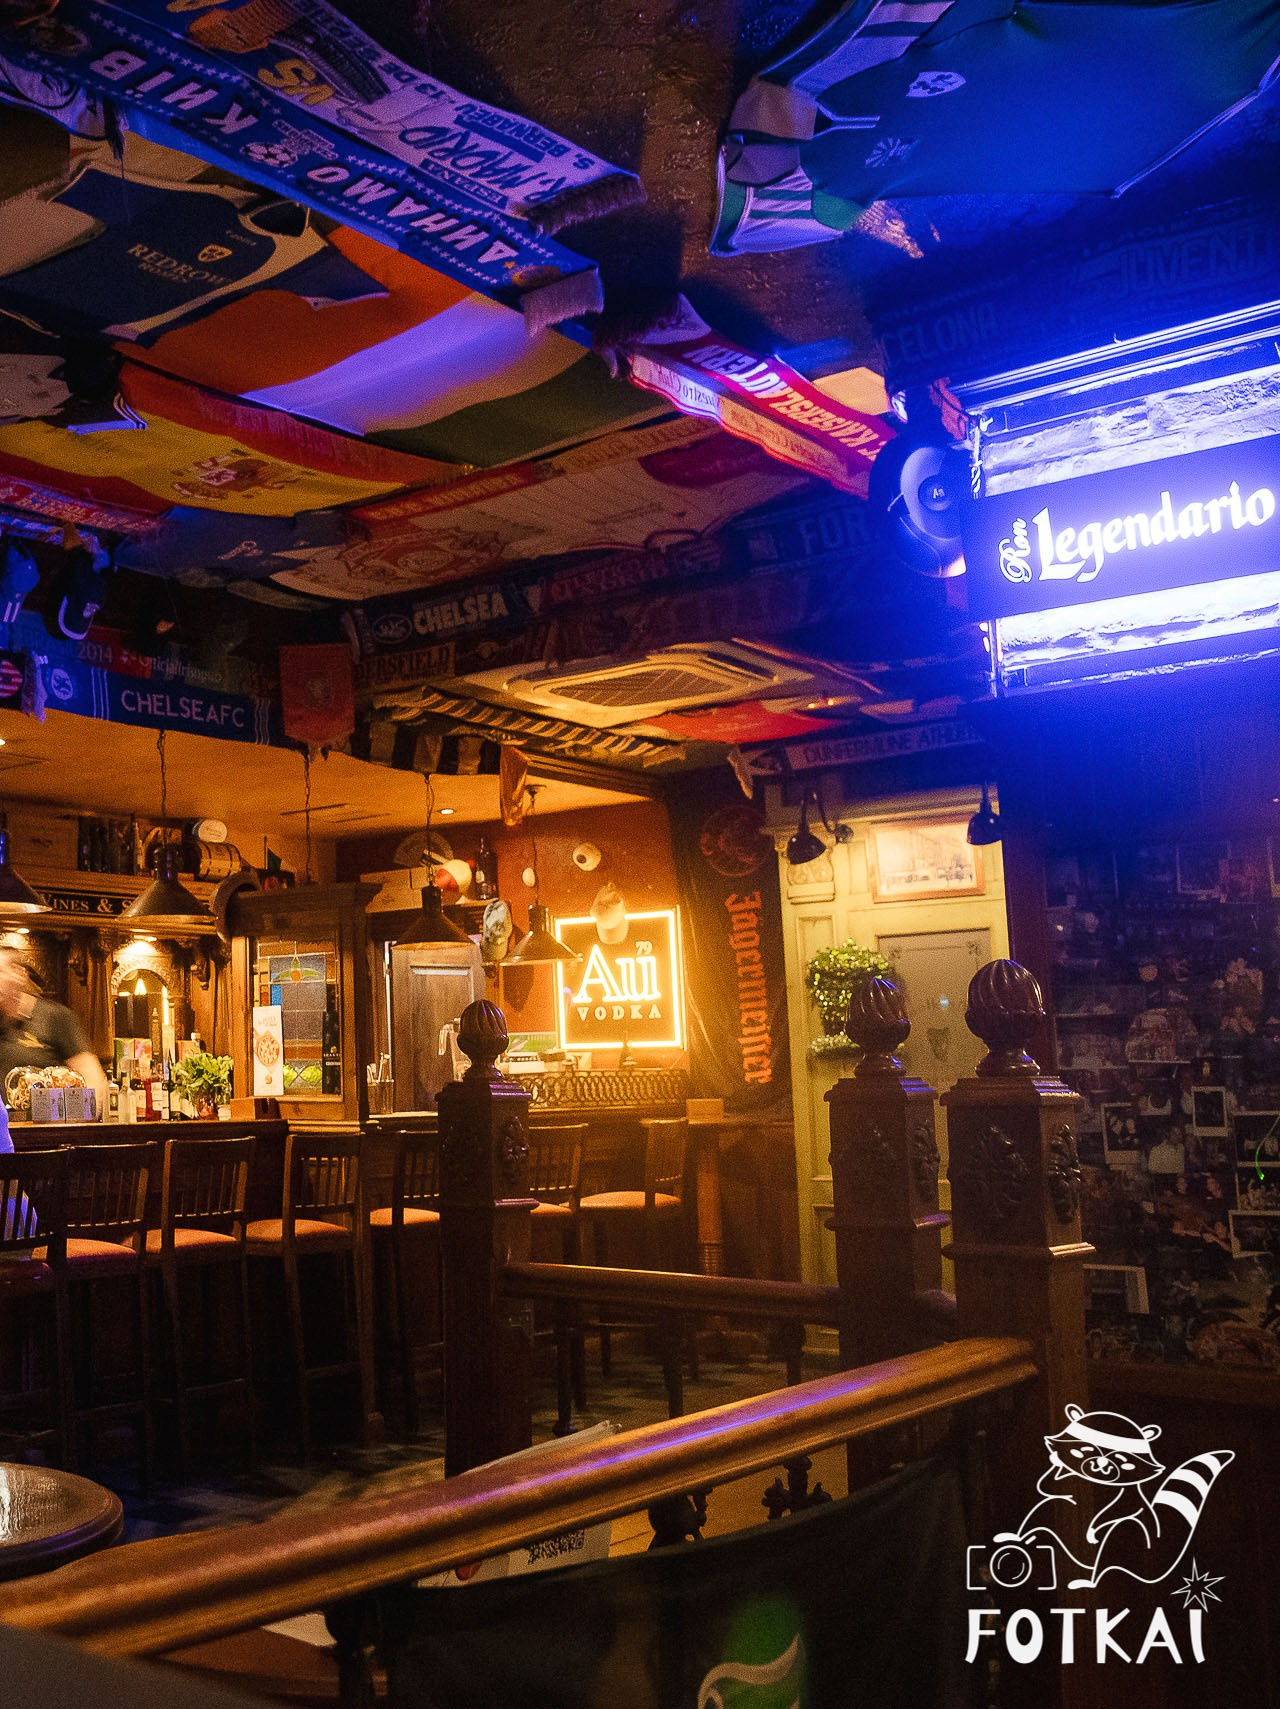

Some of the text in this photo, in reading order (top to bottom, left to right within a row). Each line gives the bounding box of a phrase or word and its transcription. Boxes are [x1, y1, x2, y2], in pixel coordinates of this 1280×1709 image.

[257, 58, 336, 106] VS
[88, 50, 519, 265] ДИНАМО КИЇВ
[998, 480, 1276, 583] Ron Legendario
[413, 591, 511, 636] CHELSEA
[96, 899, 115, 913] &
[635, 941, 653, 955] 79
[572, 943, 662, 1004] Au
[576, 1004, 662, 1022] VODKA
